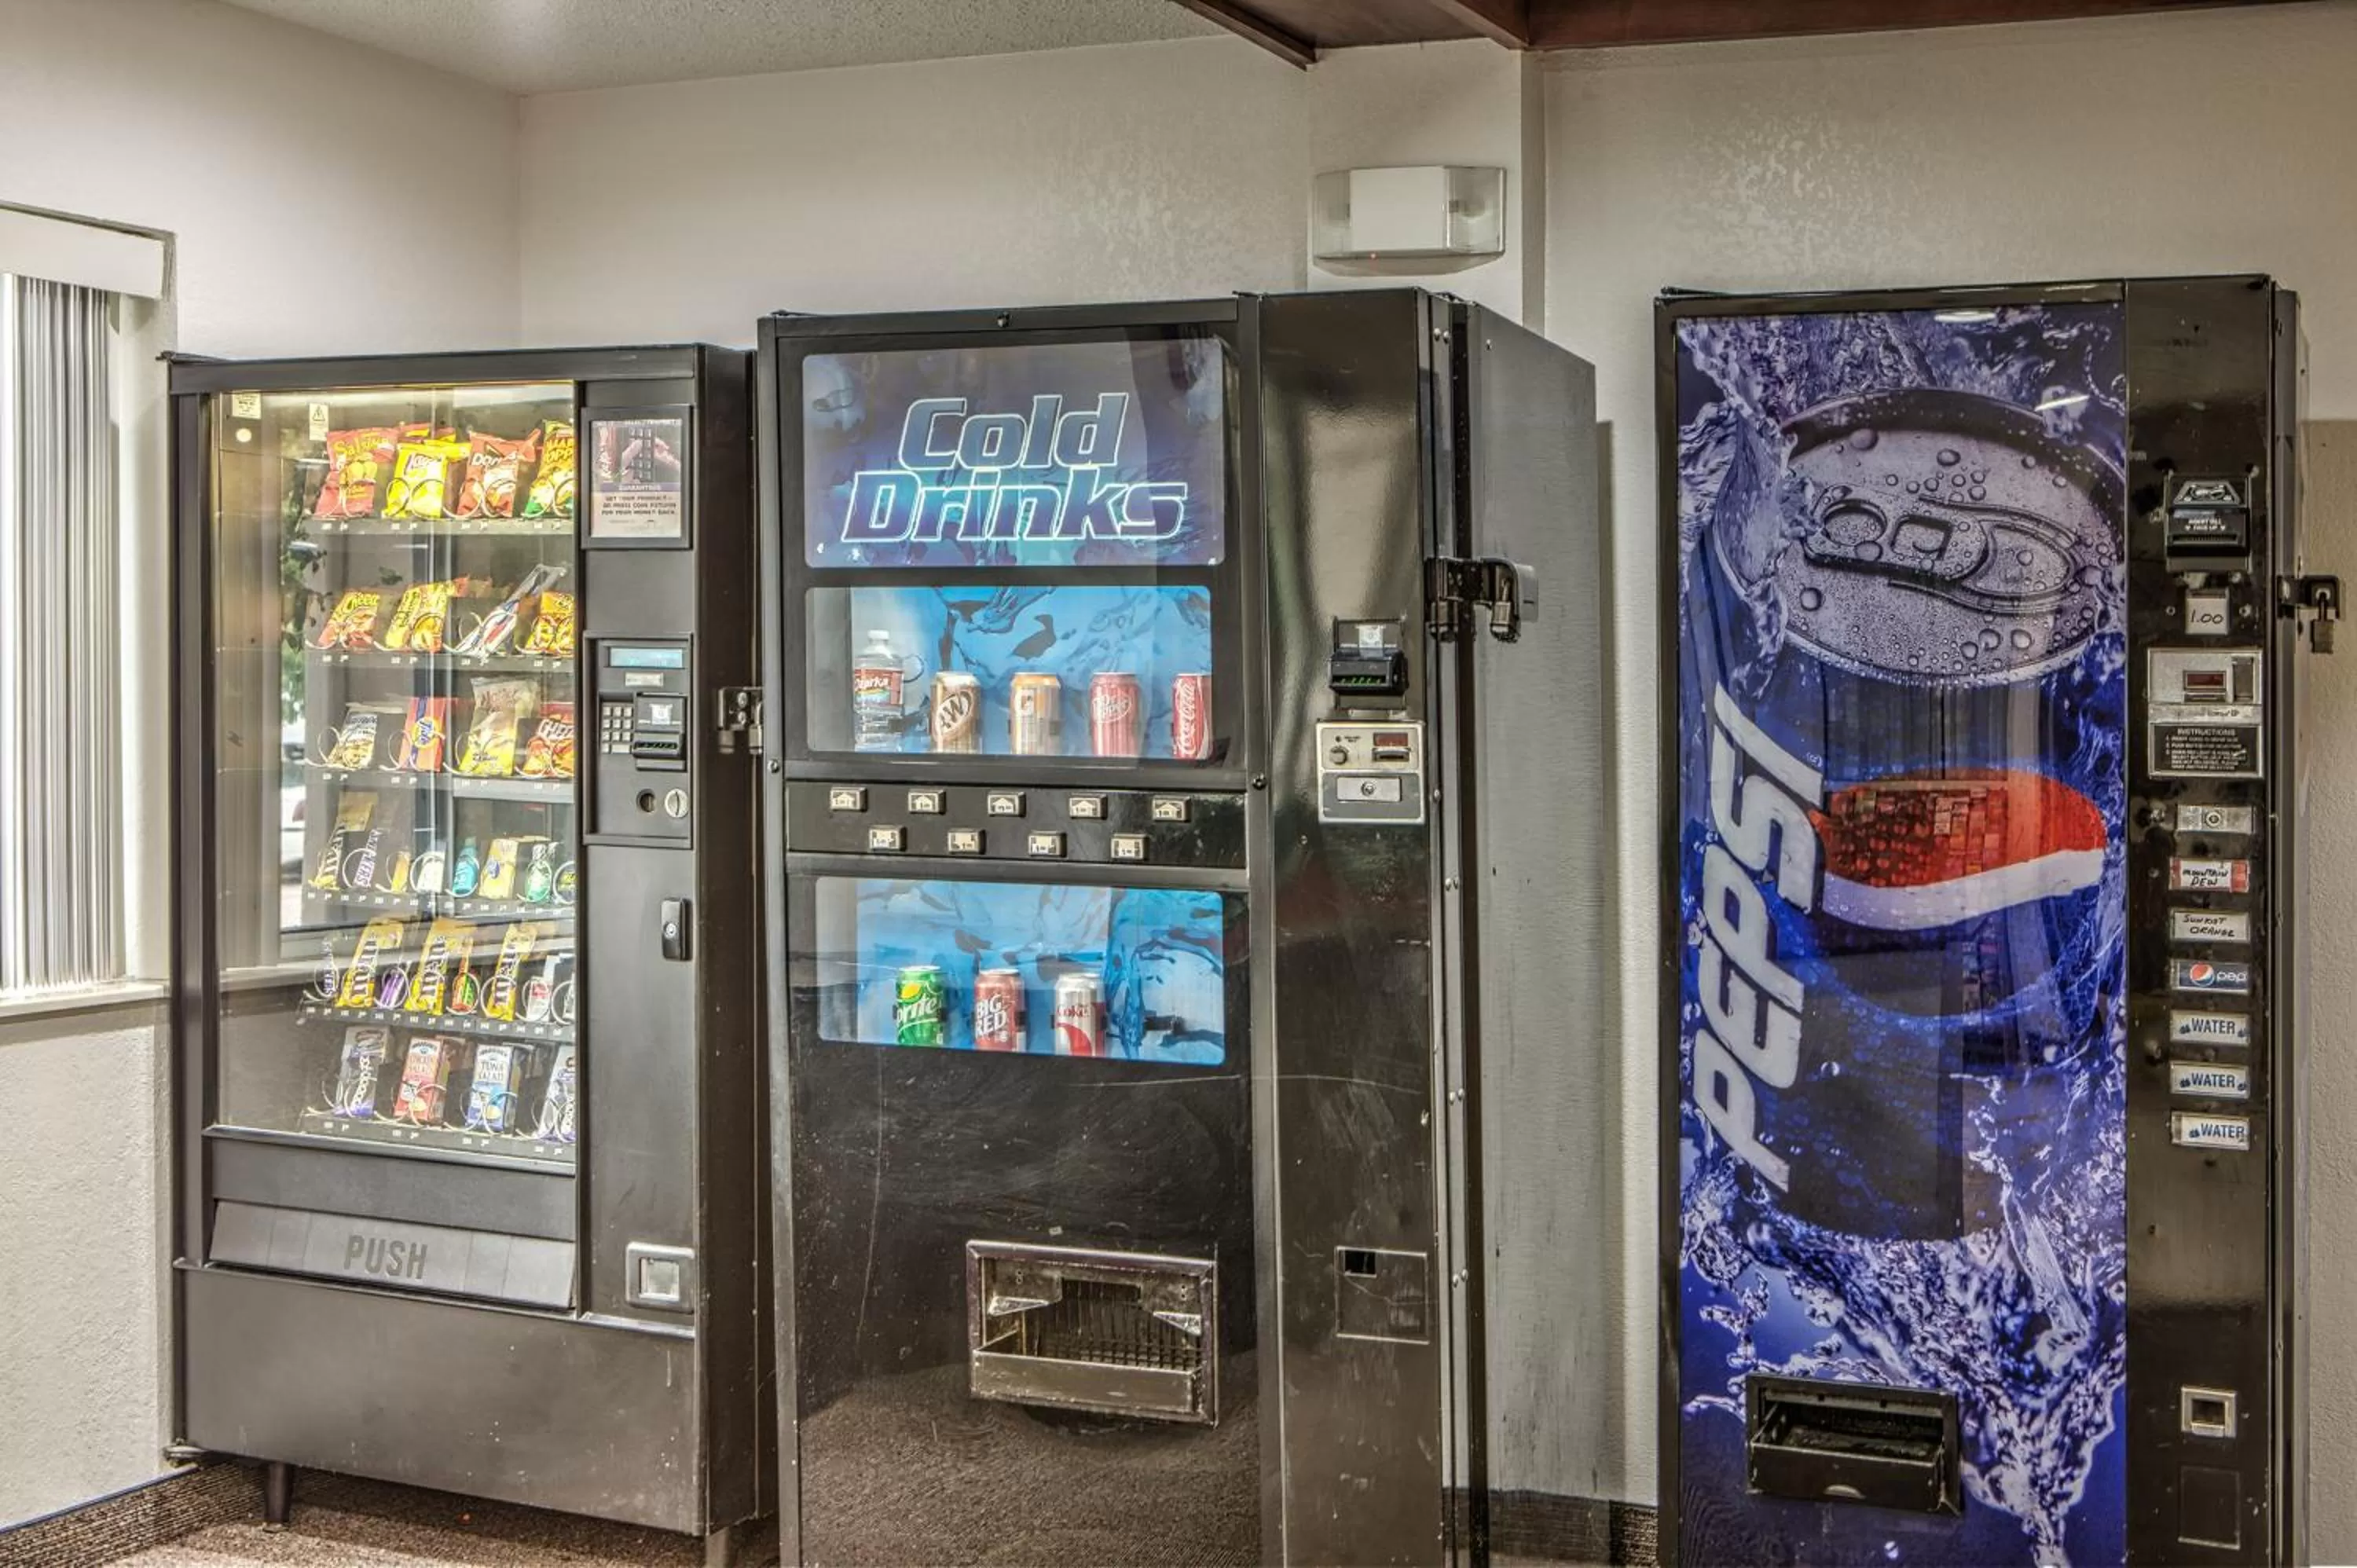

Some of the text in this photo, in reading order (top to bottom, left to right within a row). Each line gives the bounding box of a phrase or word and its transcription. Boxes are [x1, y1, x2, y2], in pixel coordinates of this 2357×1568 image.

[898, 393, 1129, 471] Cold
[841, 466, 1188, 542] Drinks
[2190, 609, 2225, 625] 1.00
[2190, 877, 2218, 886] DEW
[1693, 682, 1824, 1192] PEPSI
[2190, 926, 2235, 937] ORANGE
[976, 993, 1003, 1018] BIG
[975, 1010, 1008, 1038] RED
[2190, 1017, 2236, 1035] WATER
[2190, 1072, 2236, 1088] WATER
[2200, 1123, 2245, 1139] WATER
[343, 1234, 428, 1280] PUSH
